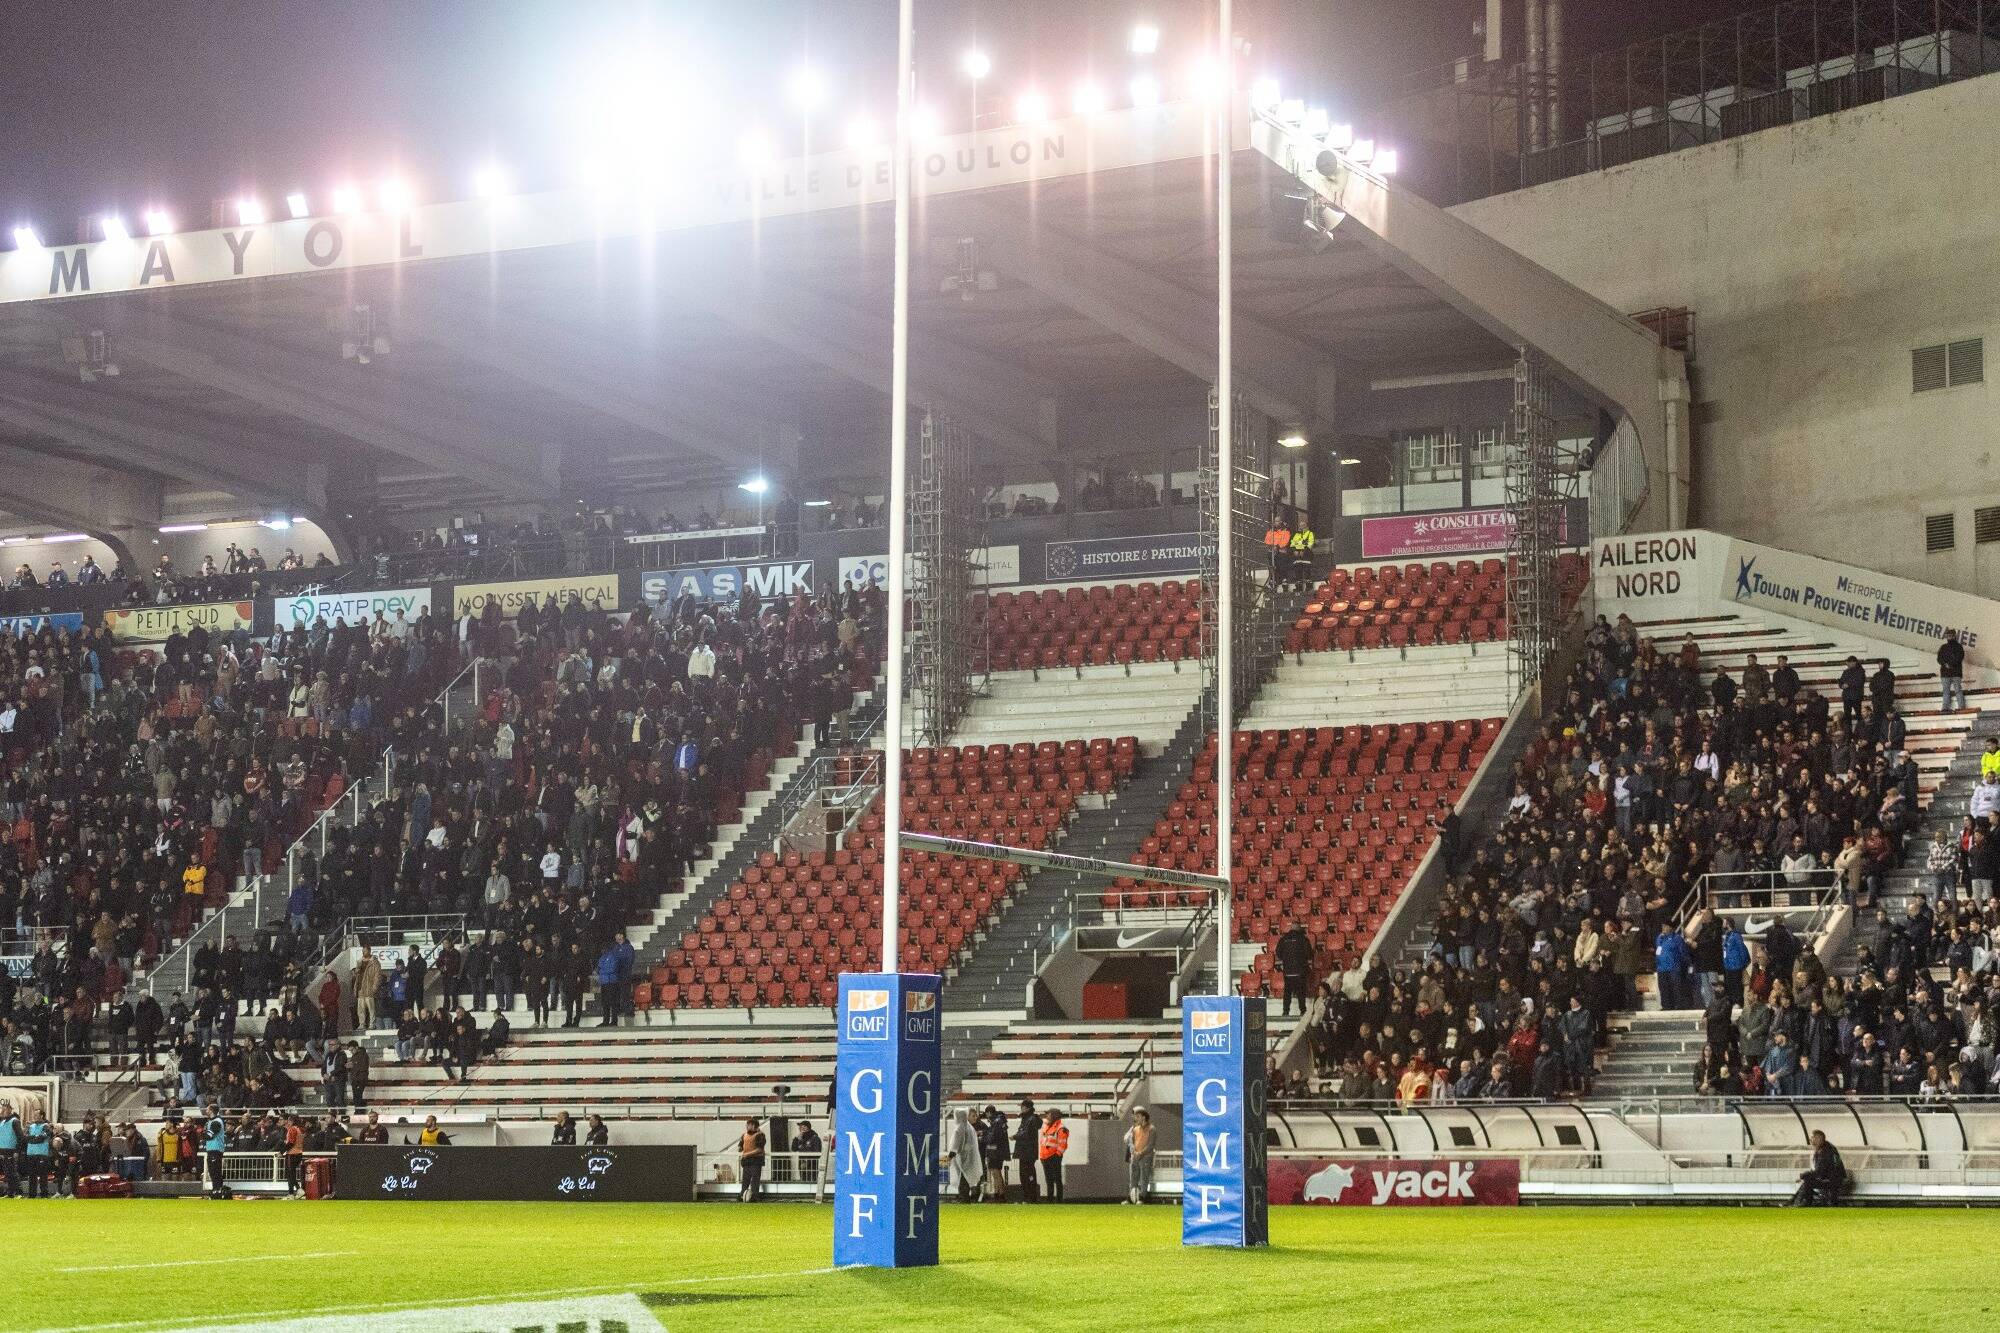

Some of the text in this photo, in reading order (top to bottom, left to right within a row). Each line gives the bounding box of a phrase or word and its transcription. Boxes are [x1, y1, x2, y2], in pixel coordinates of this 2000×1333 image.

[845, 160, 889, 188] DE
[924, 134, 1065, 177] OULON
[49, 206, 423, 294] MAYOL
[1082, 550, 1140, 565] HISTOIRE
[1600, 537, 1697, 567] AILERON
[1616, 570, 1681, 598] NORD
[1753, 572, 1799, 604] TOULON
[1803, 586, 1871, 622] PROVENCE
[137, 608, 219, 629] PETIT SUD
[319, 600, 369, 617] RATP
[851, 1016, 885, 1032] GMF
[908, 1017, 932, 1033] GMF
[1195, 1033, 1227, 1048] GMF
[845, 1068, 886, 1238] GMF
[903, 1070, 932, 1239] GMF
[1193, 1078, 1230, 1223] GMF
